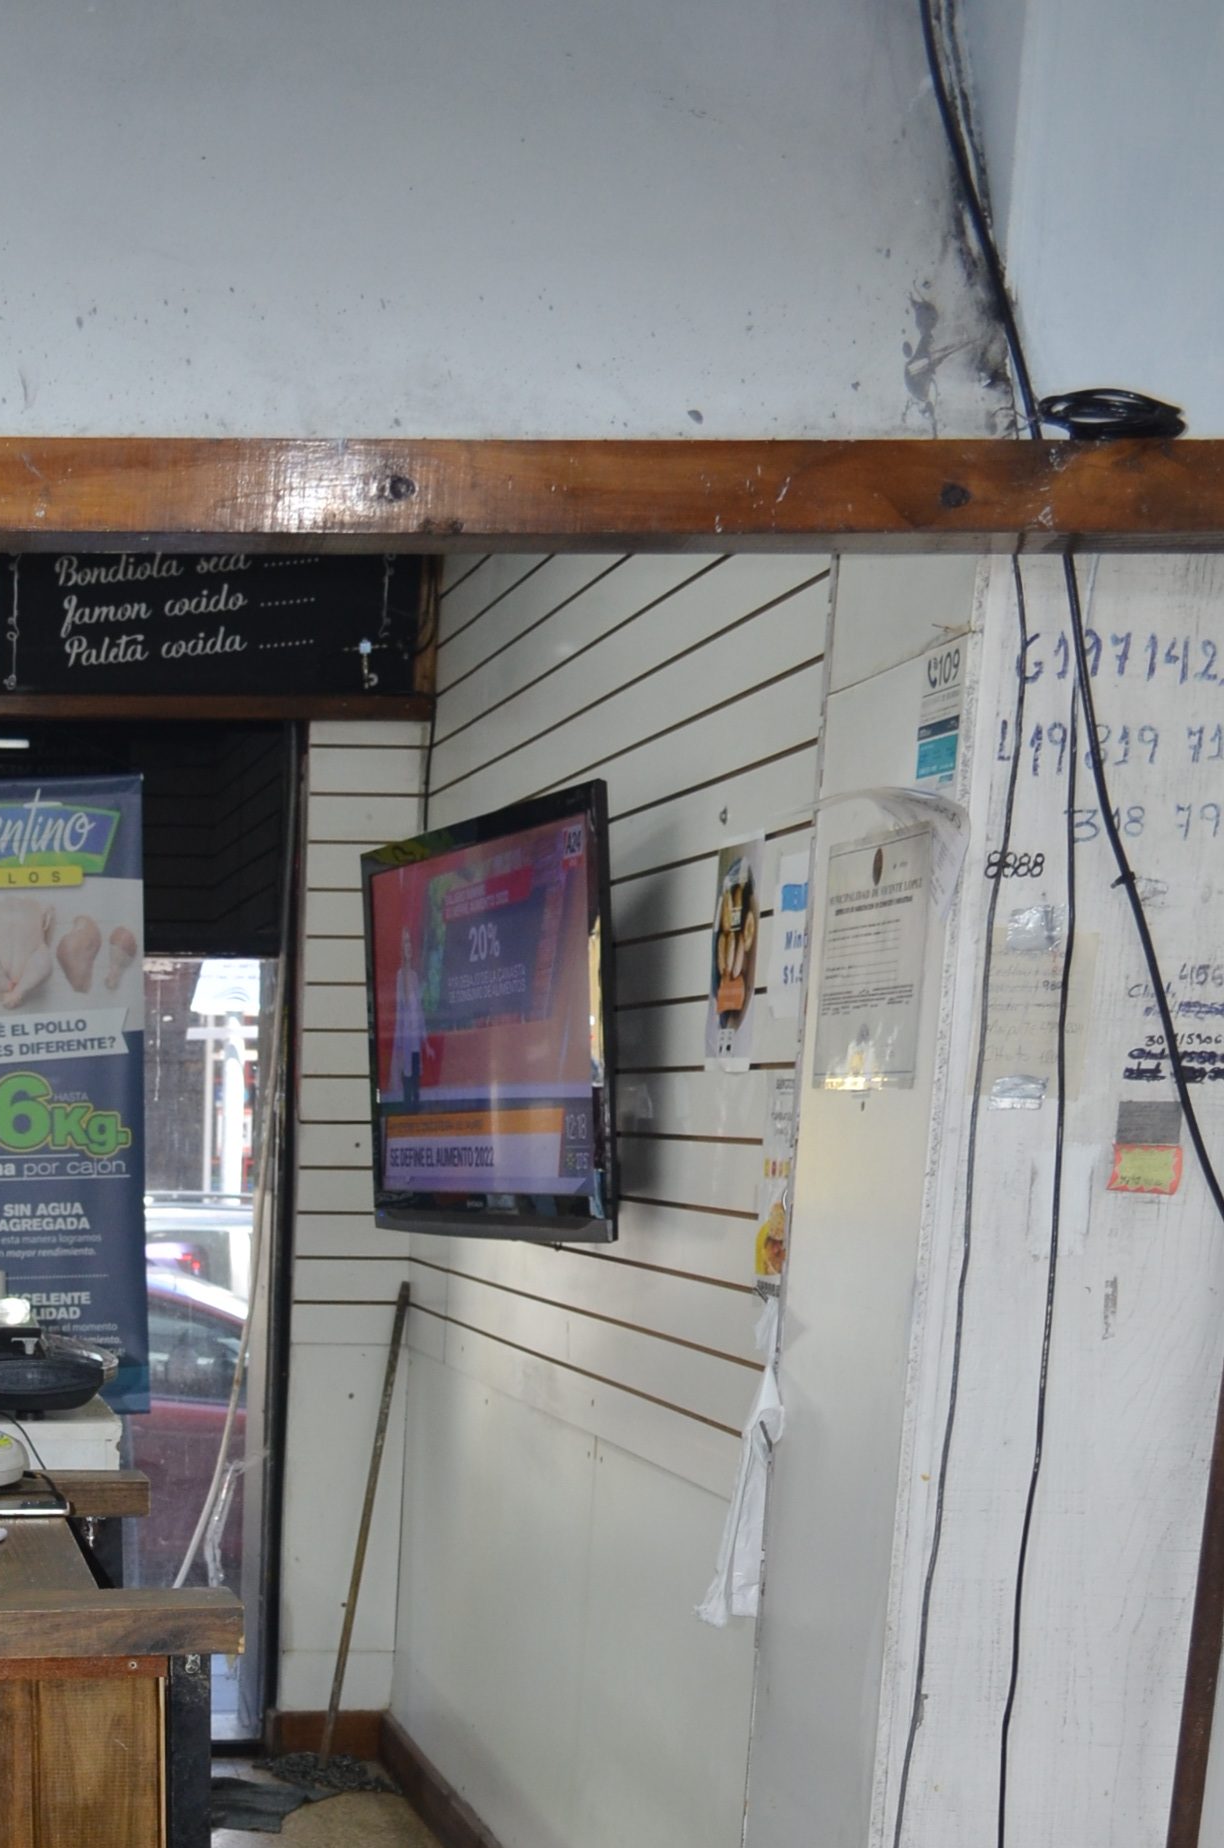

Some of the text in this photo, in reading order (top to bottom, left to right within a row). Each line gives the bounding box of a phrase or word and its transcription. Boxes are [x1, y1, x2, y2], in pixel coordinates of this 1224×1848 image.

[55, 552, 251, 587] Bondiola seca
[60, 583, 248, 638] Jamon cocido
[64, 626, 248, 668] Paleta cocida
[939, 648, 961, 687] 109
[469, 922, 501, 963] 20%
[11, 1022, 30, 1037] EL
[34, 1018, 87, 1035] POLLO
[19, 1036, 117, 1056] DIFERENTE?
[54, 1091, 89, 1103] HASTA
[23, 1162, 60, 1180] por
[66, 1156, 126, 1177] cajón
[3, 1202, 85, 1217] SIN AGUA
[1, 1235, 21, 1245] esta
[22, 1235, 57, 1244] manera
[58, 1232, 102, 1245] logramos
[5, 1249, 37, 1260] mayor
[37, 1246, 97, 1257] rendimiento.
[32, 1306, 81, 1321] LIDAD
